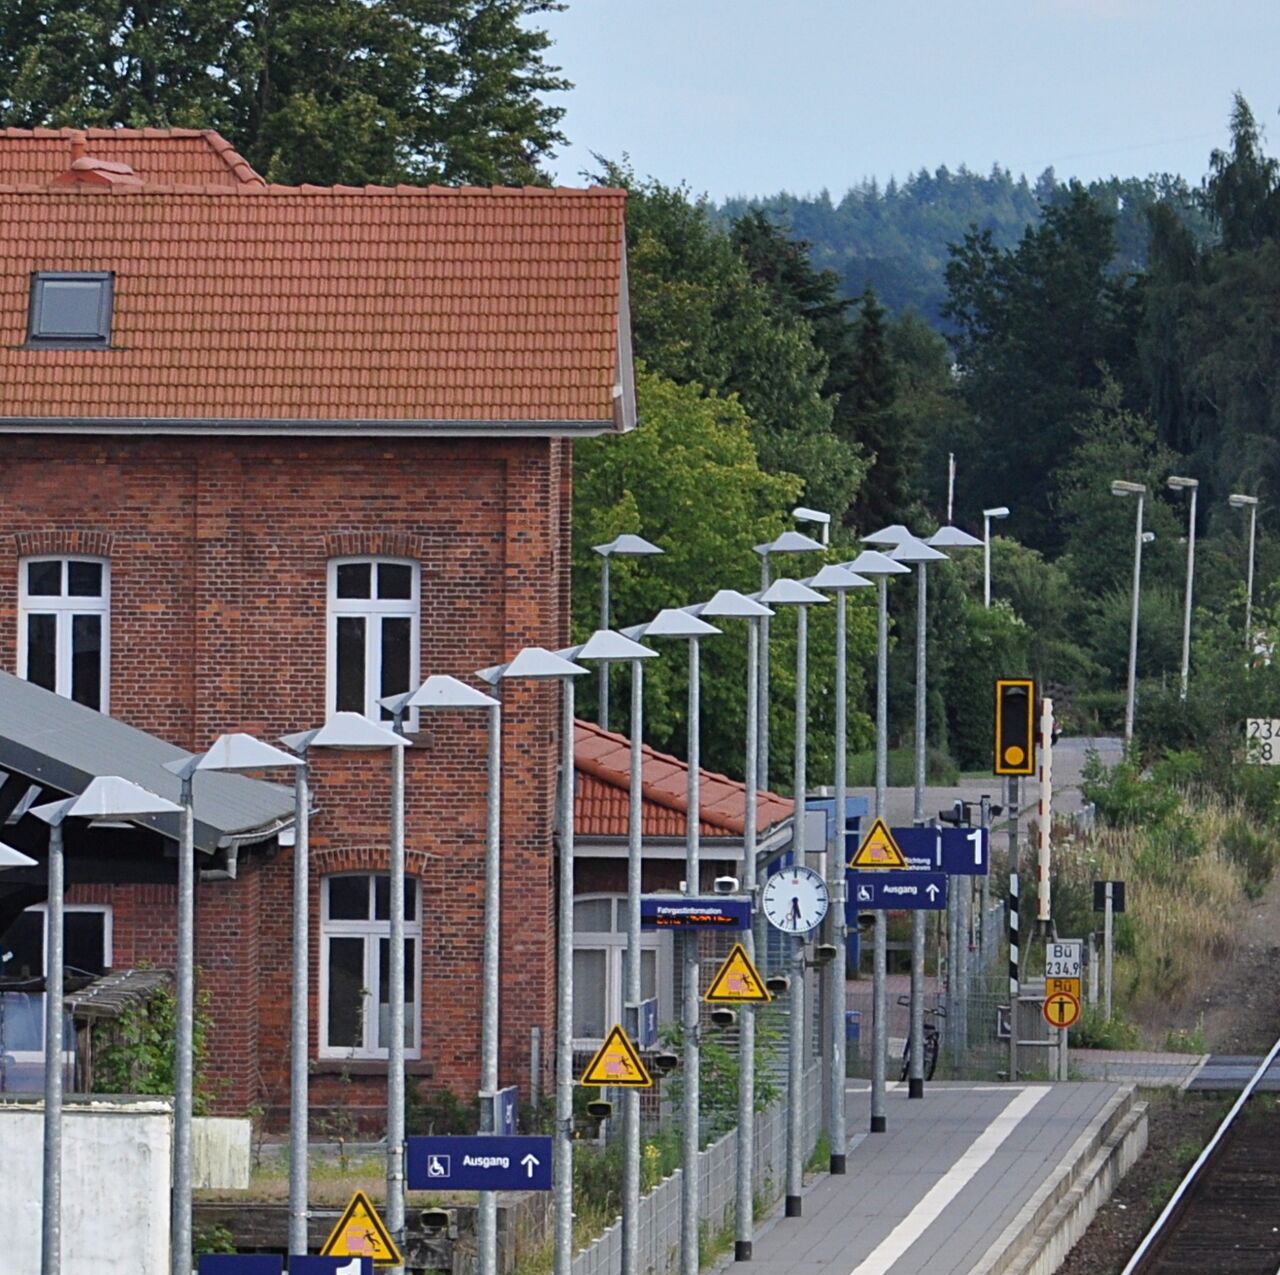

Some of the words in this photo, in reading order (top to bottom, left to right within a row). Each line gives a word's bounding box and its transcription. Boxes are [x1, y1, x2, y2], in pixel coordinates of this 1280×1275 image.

[1261, 742, 1273, 761] 8
[966, 829, 983, 865] 1
[883, 885, 918, 895] Ausgang
[1053, 945, 1072, 958] Bü
[462, 1154, 510, 1169] Ausgang
